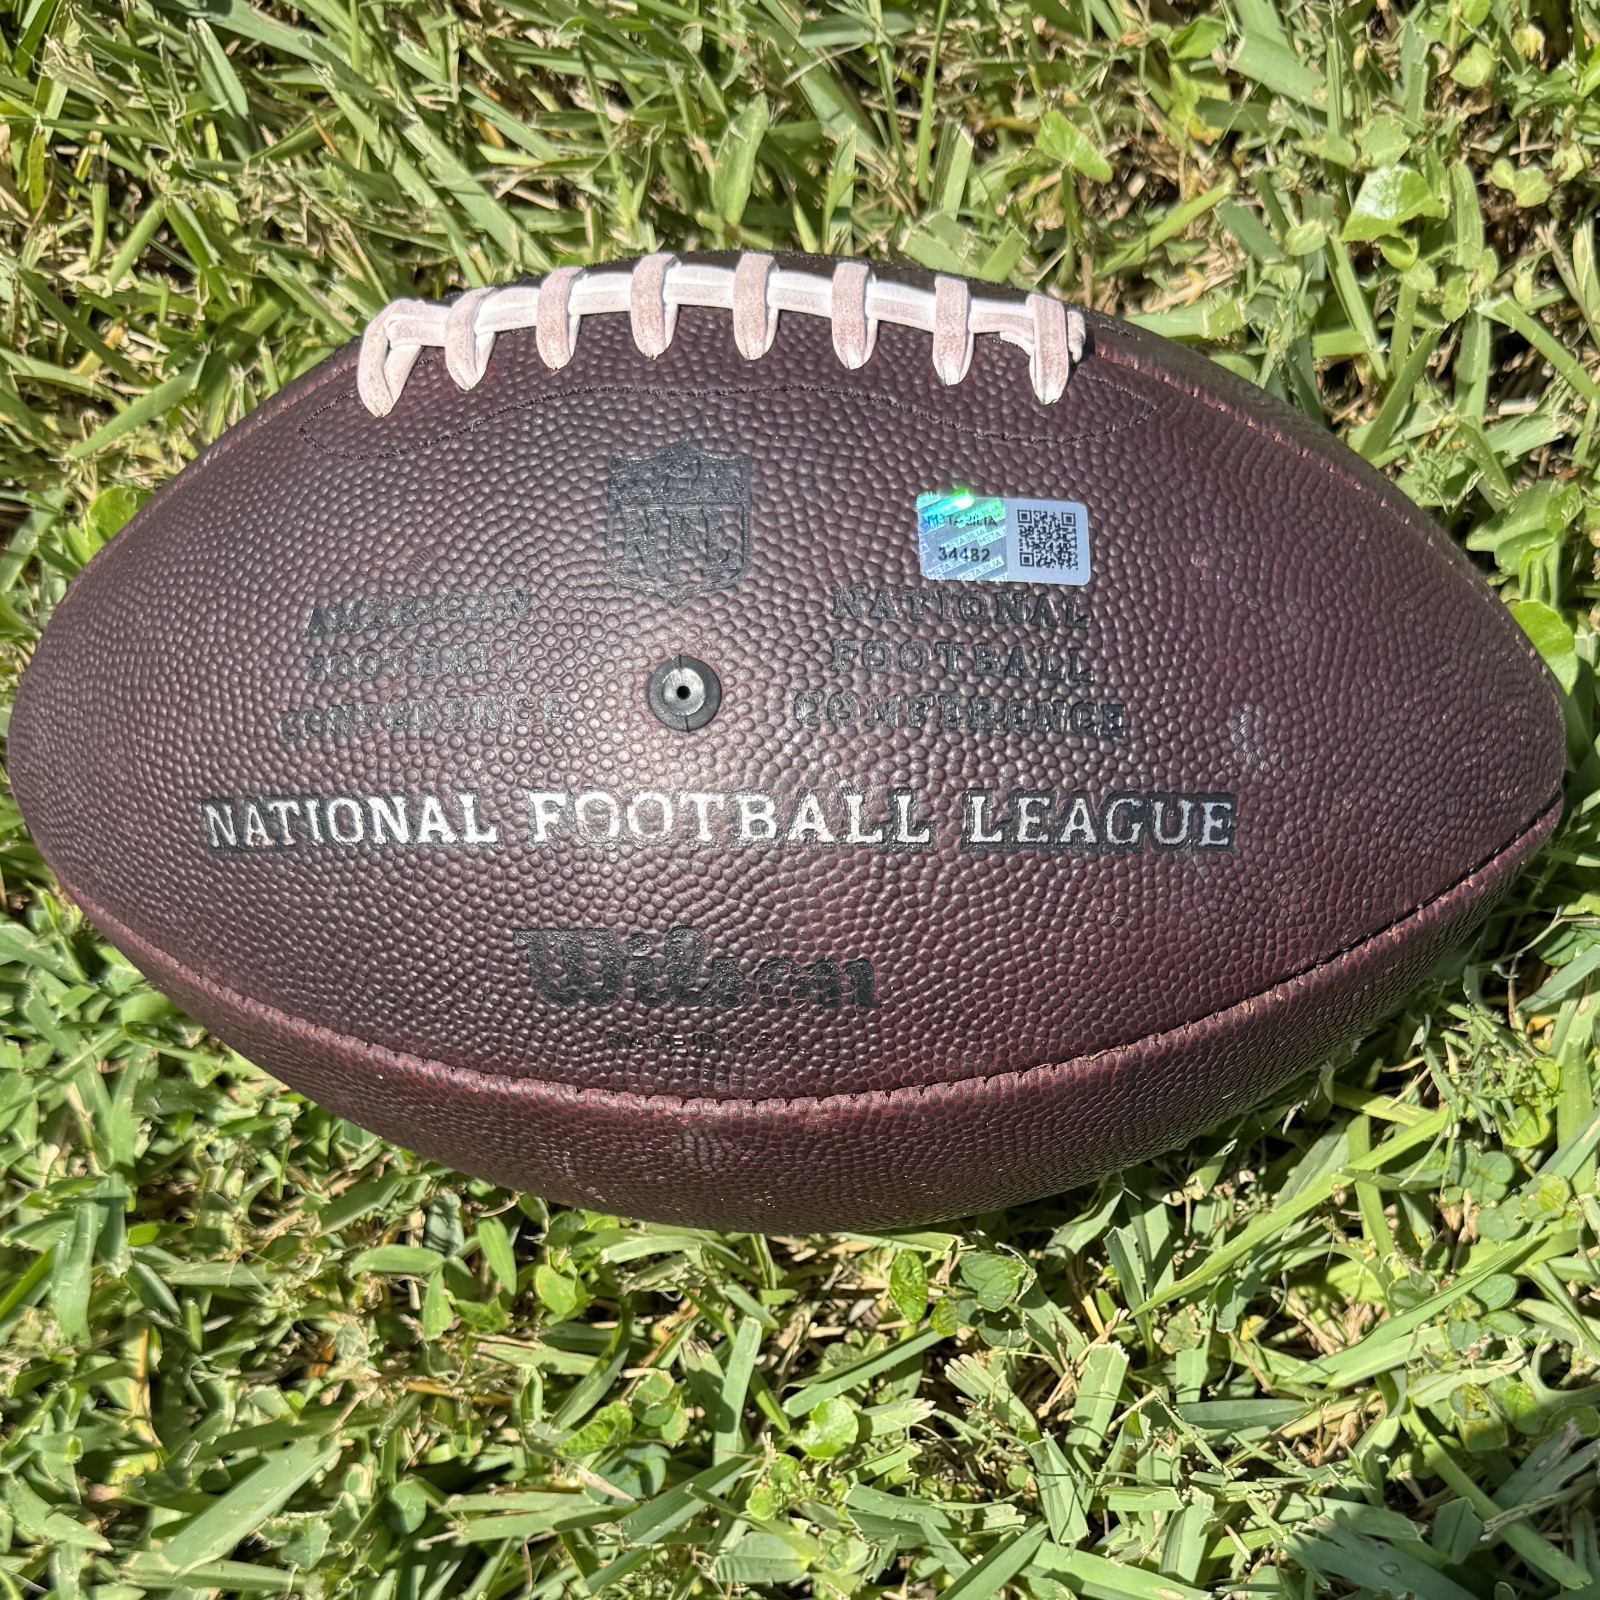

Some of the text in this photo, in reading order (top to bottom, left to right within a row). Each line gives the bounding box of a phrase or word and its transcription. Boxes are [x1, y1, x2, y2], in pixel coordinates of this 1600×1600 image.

[938, 546, 991, 562] 34482
[829, 586, 1093, 630] NATIONAL
[829, 638, 1096, 682] FOOTBALL
[793, 690, 1126, 740] CONFERENCE
[203, 790, 1234, 848] NATIONAL FOOTBALL LEAGUE
[514, 924, 881, 1009] Wilson
